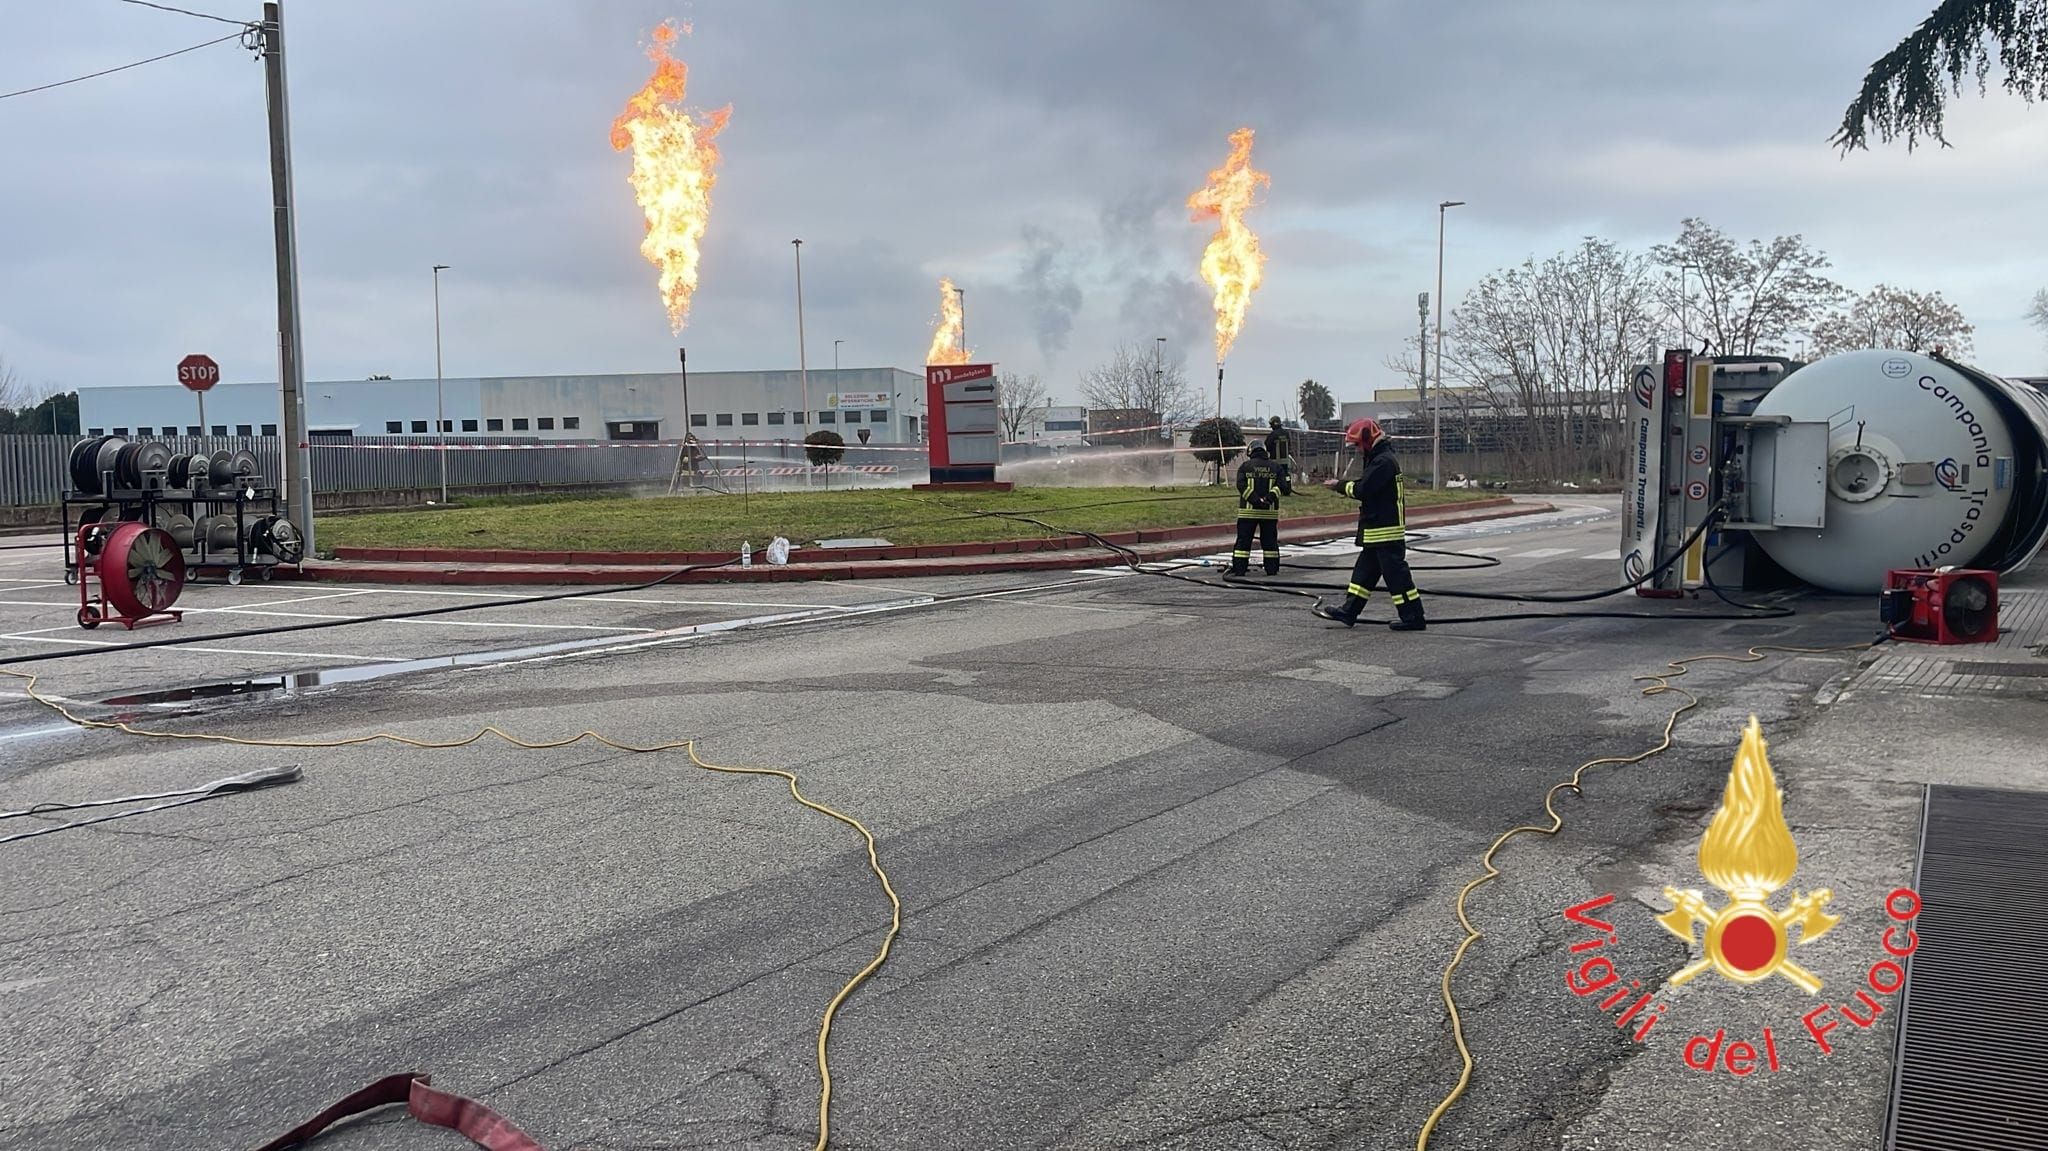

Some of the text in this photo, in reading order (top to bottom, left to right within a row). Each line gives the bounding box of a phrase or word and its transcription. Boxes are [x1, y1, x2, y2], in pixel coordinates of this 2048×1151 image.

[181, 366, 217, 380] STOP
[1637, 418, 1649, 474] Campania
[1694, 450, 1704, 461] 70
[1914, 375, 1993, 569] Campania Trasporti
[1636, 478, 1647, 530] Trasporti
[1692, 485, 1702, 497] 80
